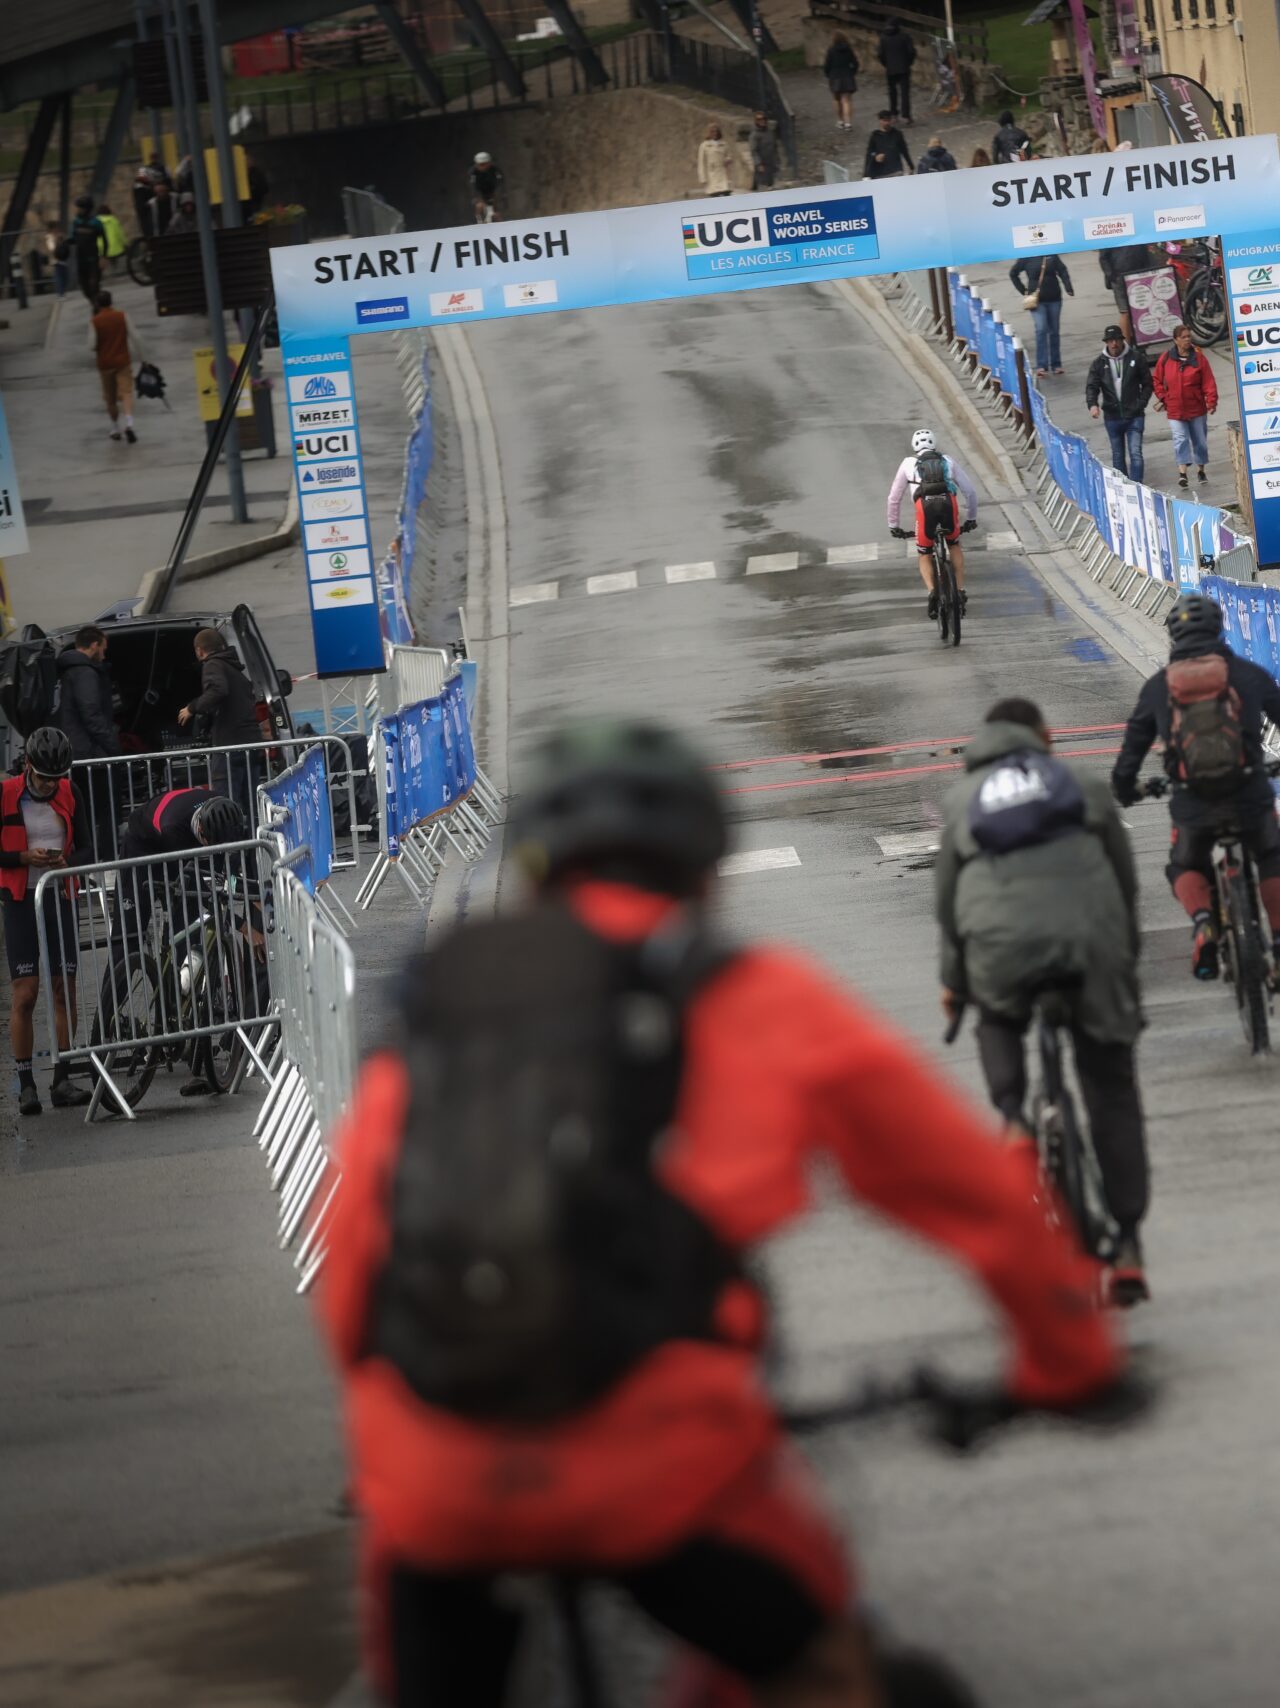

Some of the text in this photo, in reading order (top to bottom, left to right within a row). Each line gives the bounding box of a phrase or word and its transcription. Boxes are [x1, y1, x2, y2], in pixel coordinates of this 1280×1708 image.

[992, 154, 1236, 208] START / FINISH
[773, 209, 825, 225] GRAVEL
[697, 217, 762, 247] UCI
[774, 218, 869, 239] WORLD SERIES
[314, 230, 570, 284] START / FINISH
[711, 244, 855, 271] LES ANGLES FRANCE
[360, 305, 405, 317] SHIMANO
[1257, 360, 1273, 373] ici
[299, 409, 350, 423] MAZET
[305, 435, 349, 455] UCI
